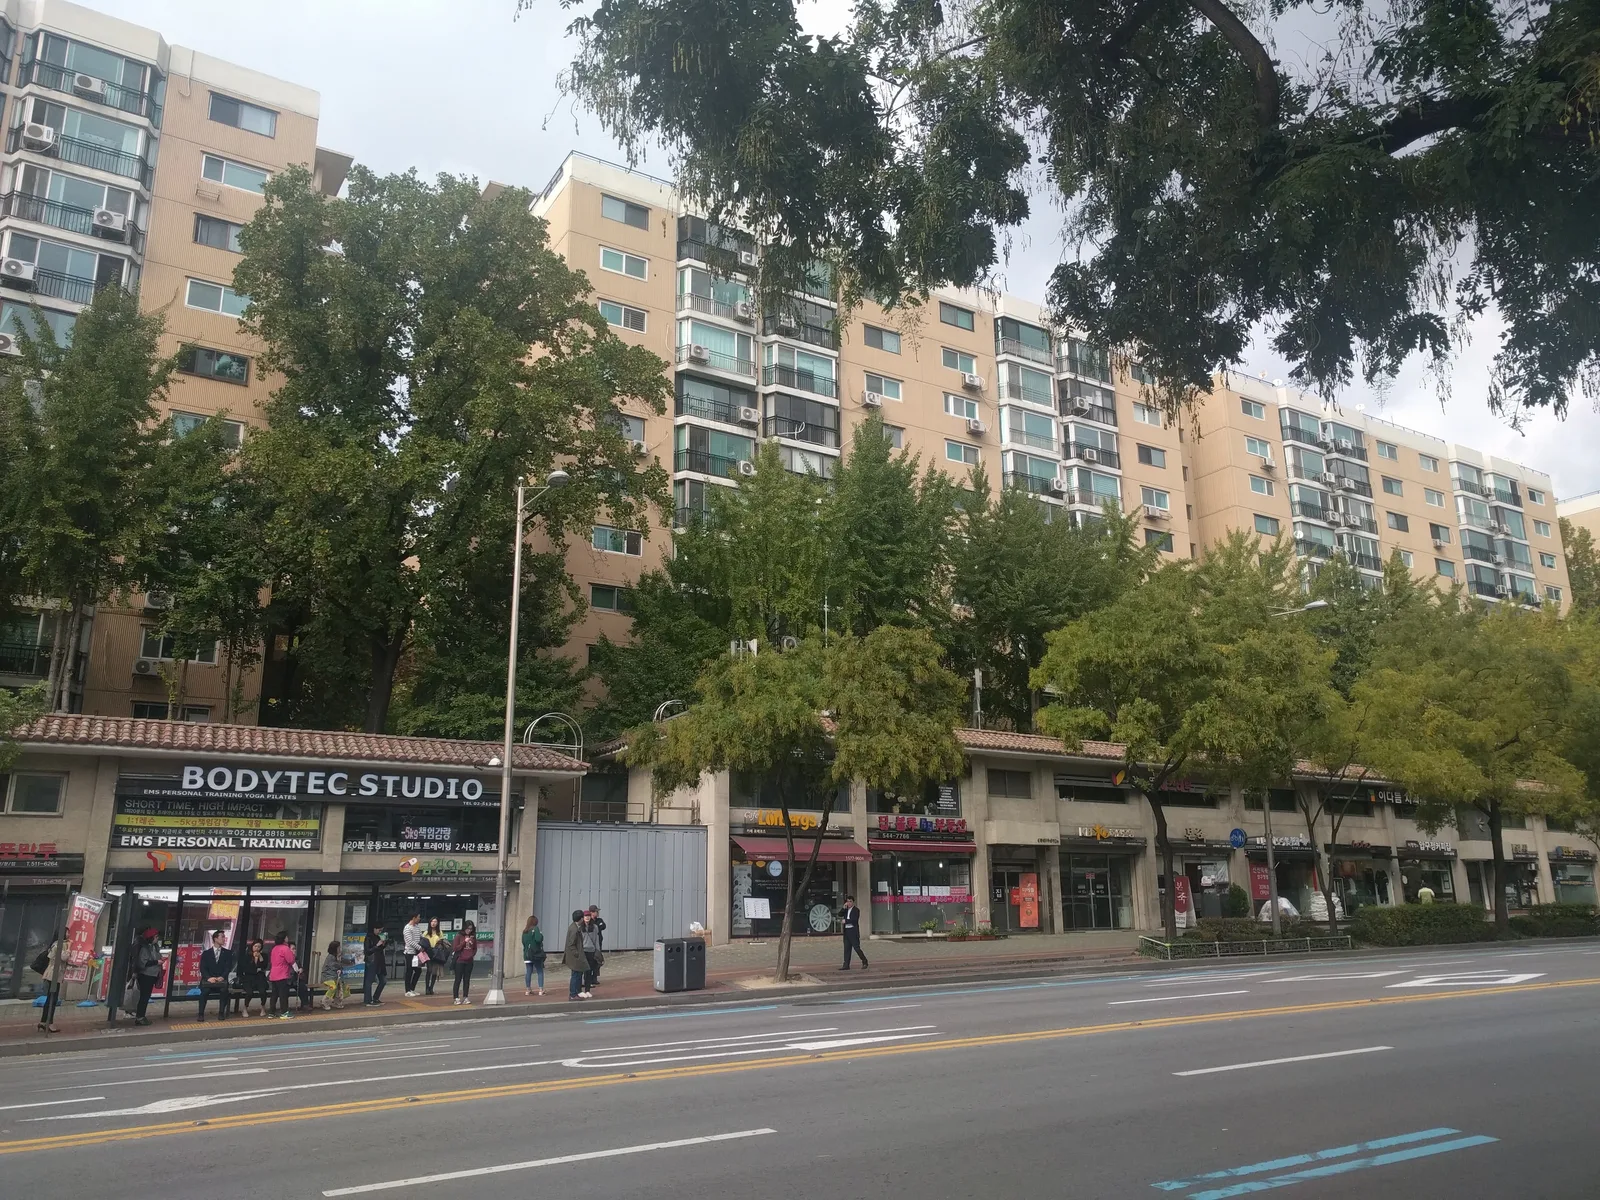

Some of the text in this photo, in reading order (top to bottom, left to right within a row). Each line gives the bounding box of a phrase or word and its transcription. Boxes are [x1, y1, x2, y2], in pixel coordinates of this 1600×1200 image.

[182, 766, 483, 800] BODYTEC STUDIO
[162, 789, 203, 798] PERSONAL
[204, 791, 243, 799] TRAINING
[244, 792, 265, 800] YOGA
[266, 793, 297, 801] PILATES
[125, 799, 265, 813] SHORT TIME, HIGH IMPACT
[234, 829, 285, 838] 02.512.8818
[120, 835, 312, 850] EMS PERSONAL TRAINING
[366, 841, 397, 851] 운동으로
[176, 855, 255, 872] WORLD
[75, 931, 88, 943] TV
